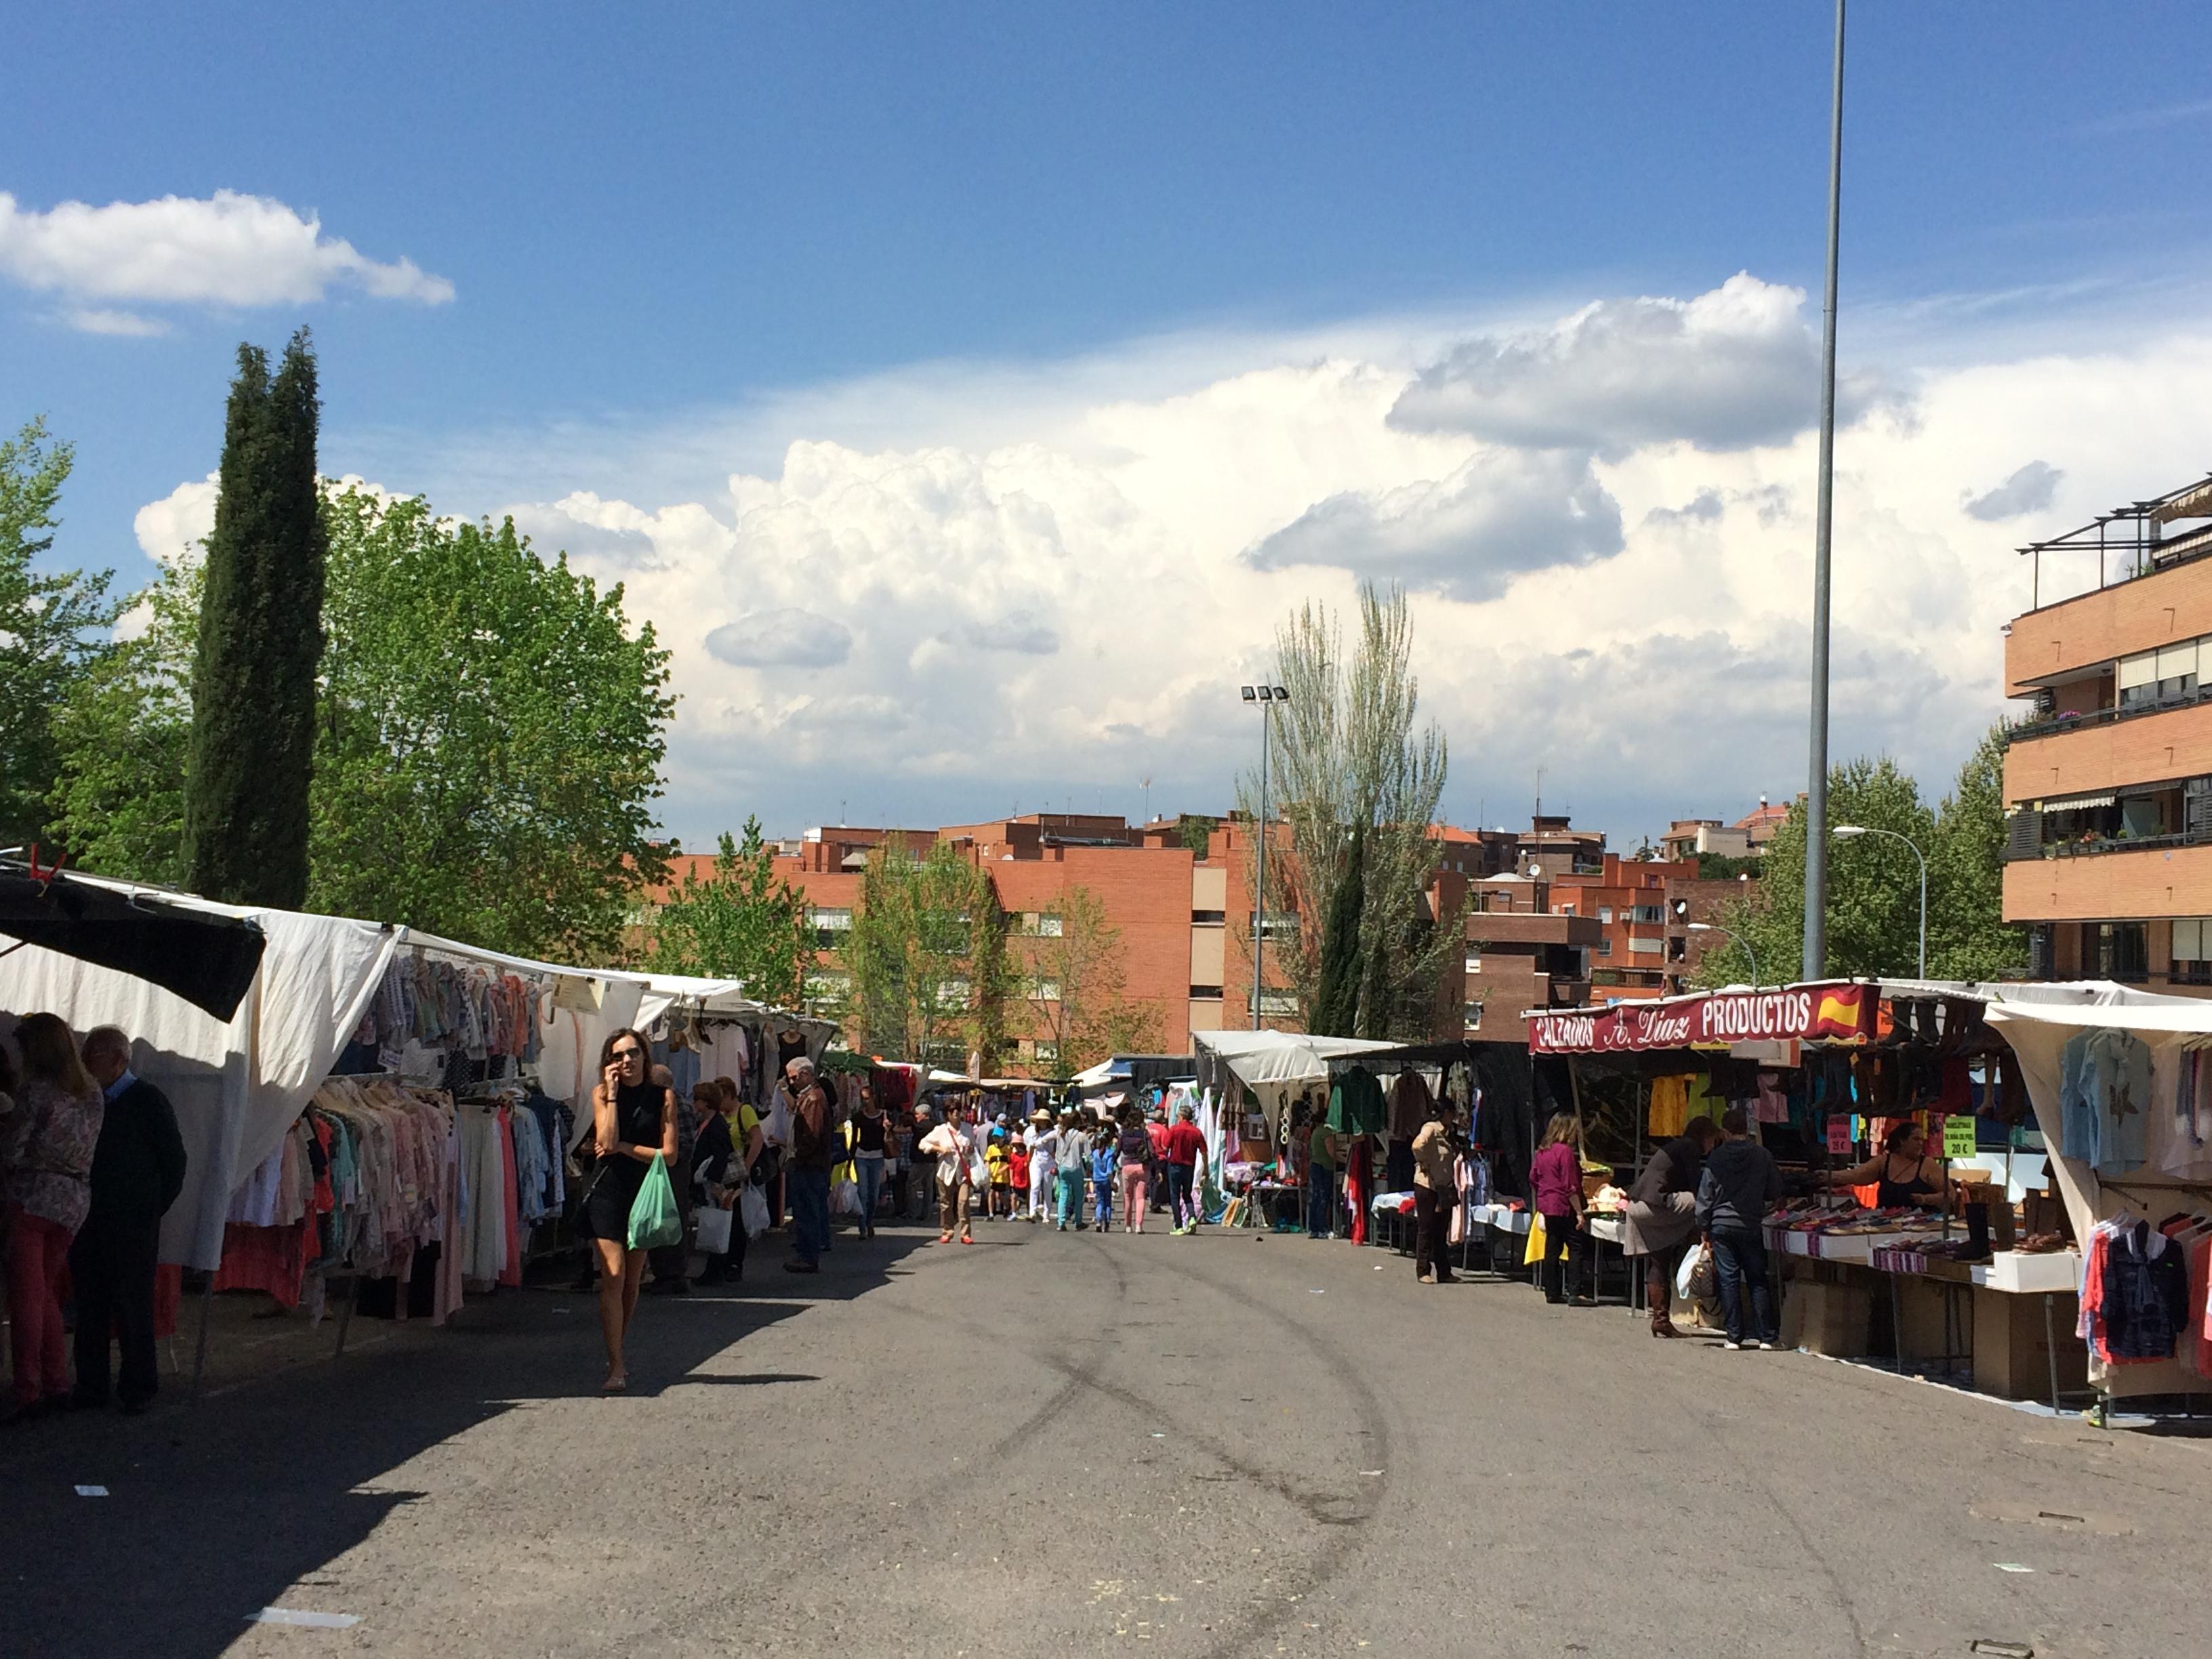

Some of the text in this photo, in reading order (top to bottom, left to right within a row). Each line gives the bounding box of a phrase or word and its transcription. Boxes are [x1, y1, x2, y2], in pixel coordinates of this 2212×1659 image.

[1536, 1016, 1595, 1047] CALZADOS
[1702, 991, 1811, 1036] PRODUCTOS
[1952, 1143, 1968, 1154] 20 €
